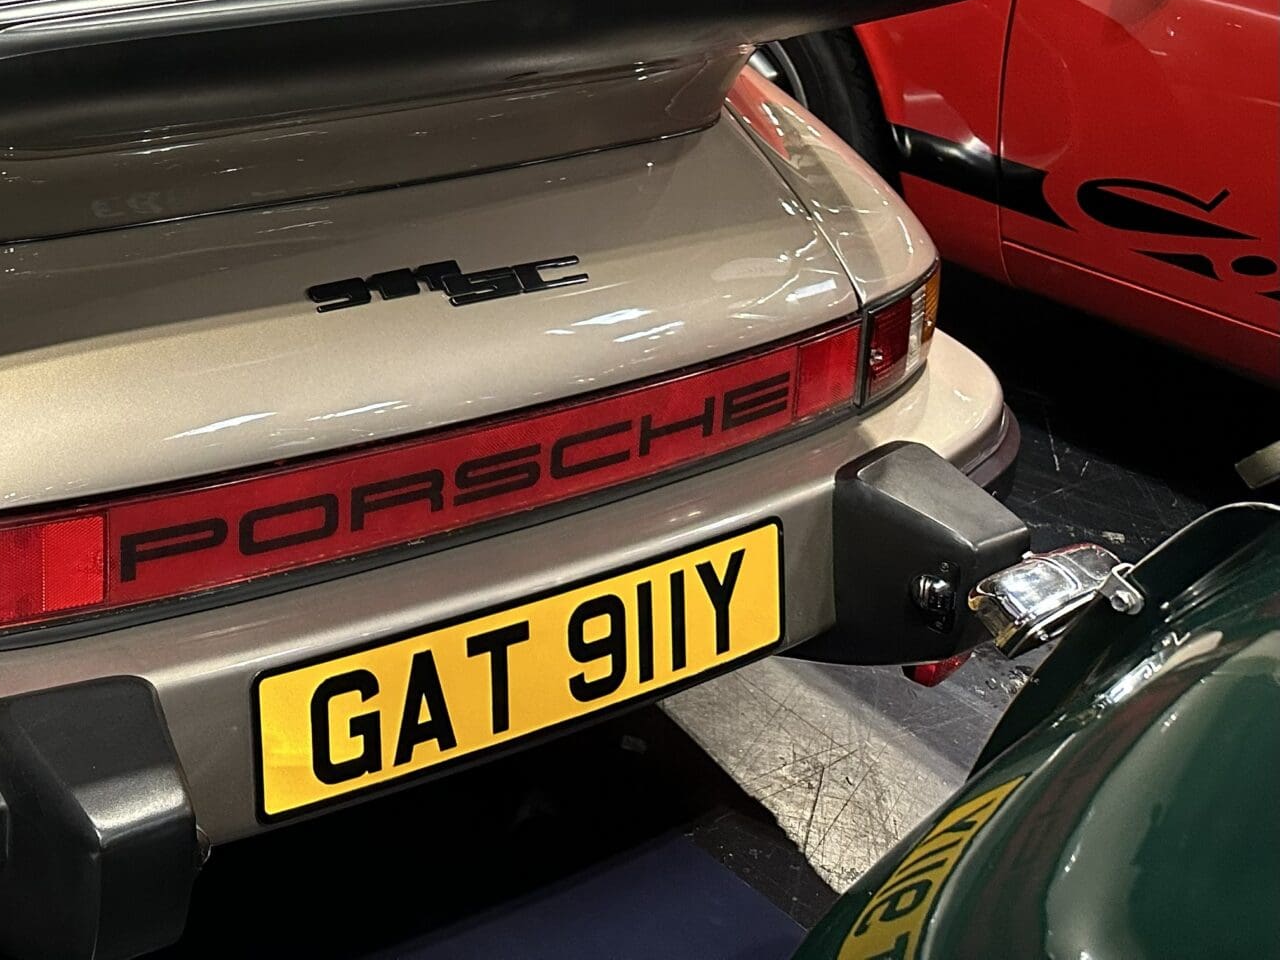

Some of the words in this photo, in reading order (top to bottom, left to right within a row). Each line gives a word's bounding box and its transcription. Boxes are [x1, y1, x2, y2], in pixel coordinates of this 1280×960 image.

[120, 372, 791, 584] PORSCHE
[310, 620, 530, 786] GAT
[567, 548, 746, 703] 911Y
